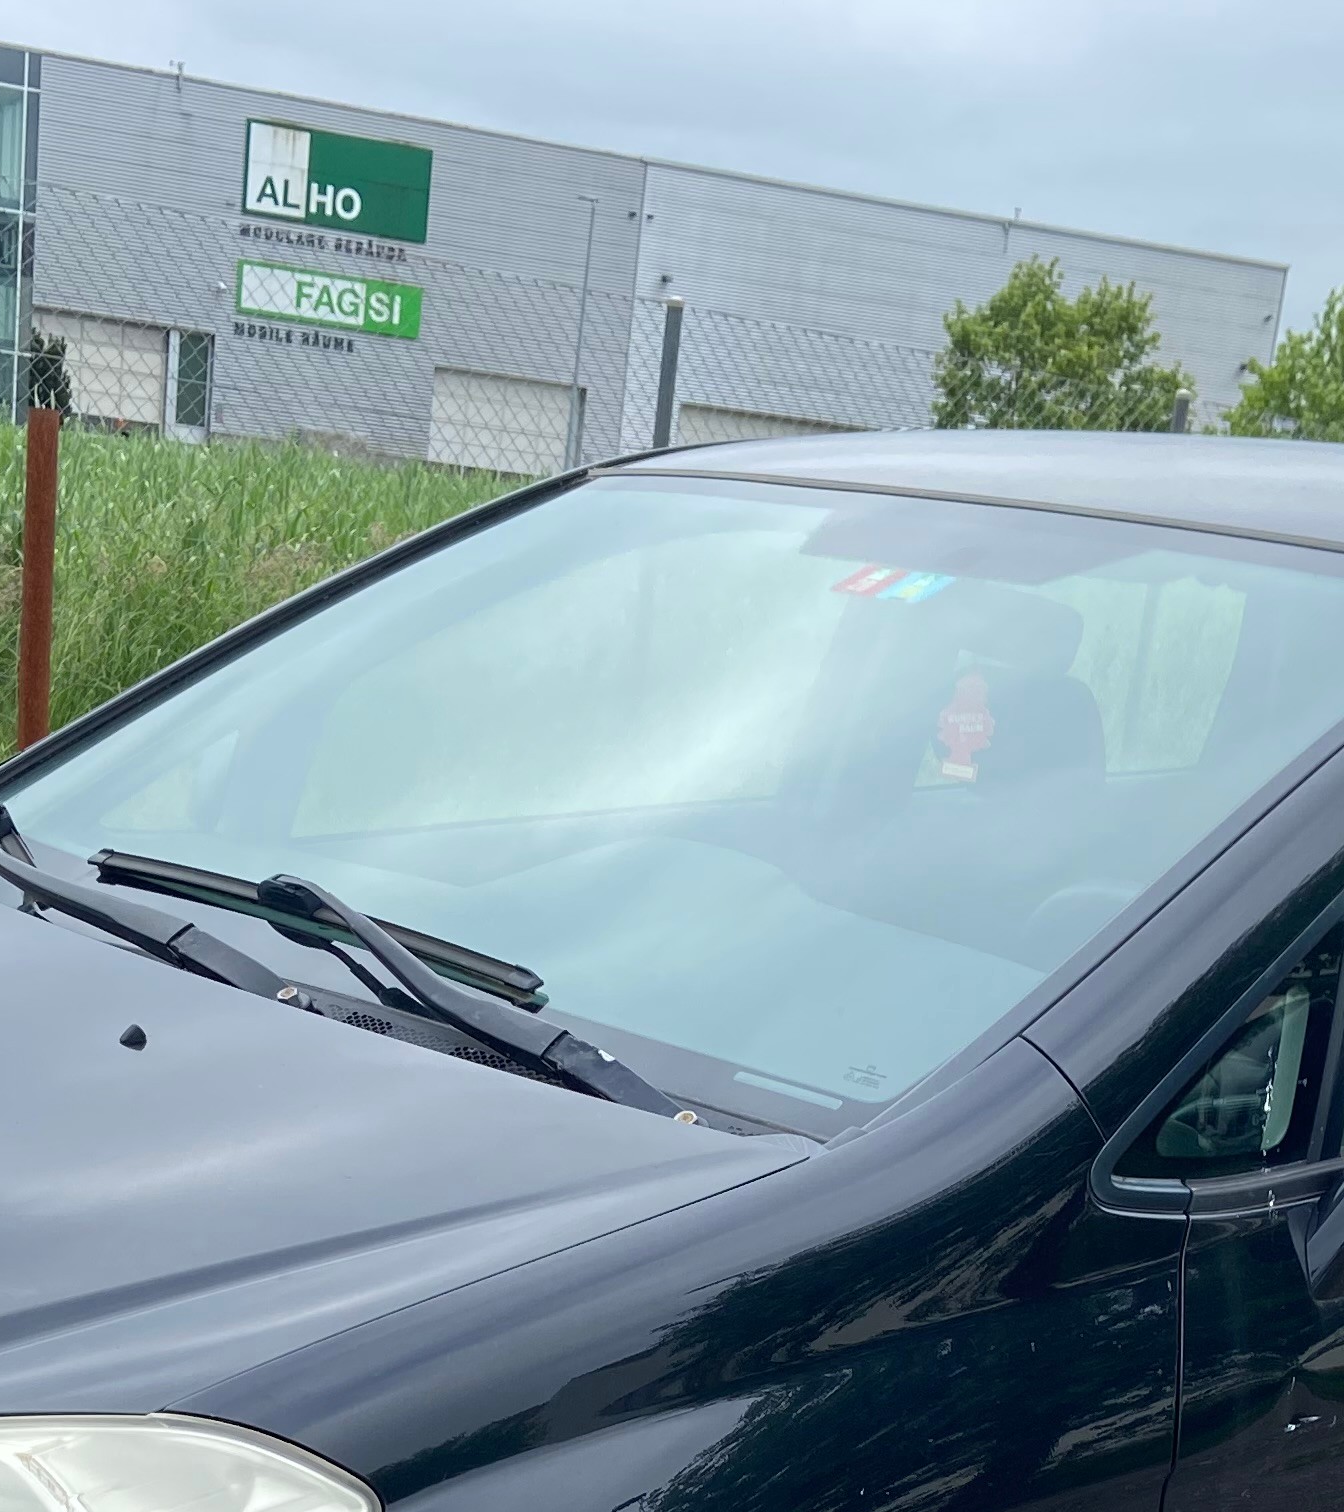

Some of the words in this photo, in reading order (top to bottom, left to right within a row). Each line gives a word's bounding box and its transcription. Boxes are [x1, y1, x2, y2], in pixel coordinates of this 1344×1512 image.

[256, 175, 362, 220] ALHO
[240, 222, 326, 249] MODULARE
[334, 237, 407, 262] GEBÄUDE
[295, 280, 401, 325] FAGSI
[233, 321, 293, 345] MOBILE
[301, 330, 355, 353] RÄUME
